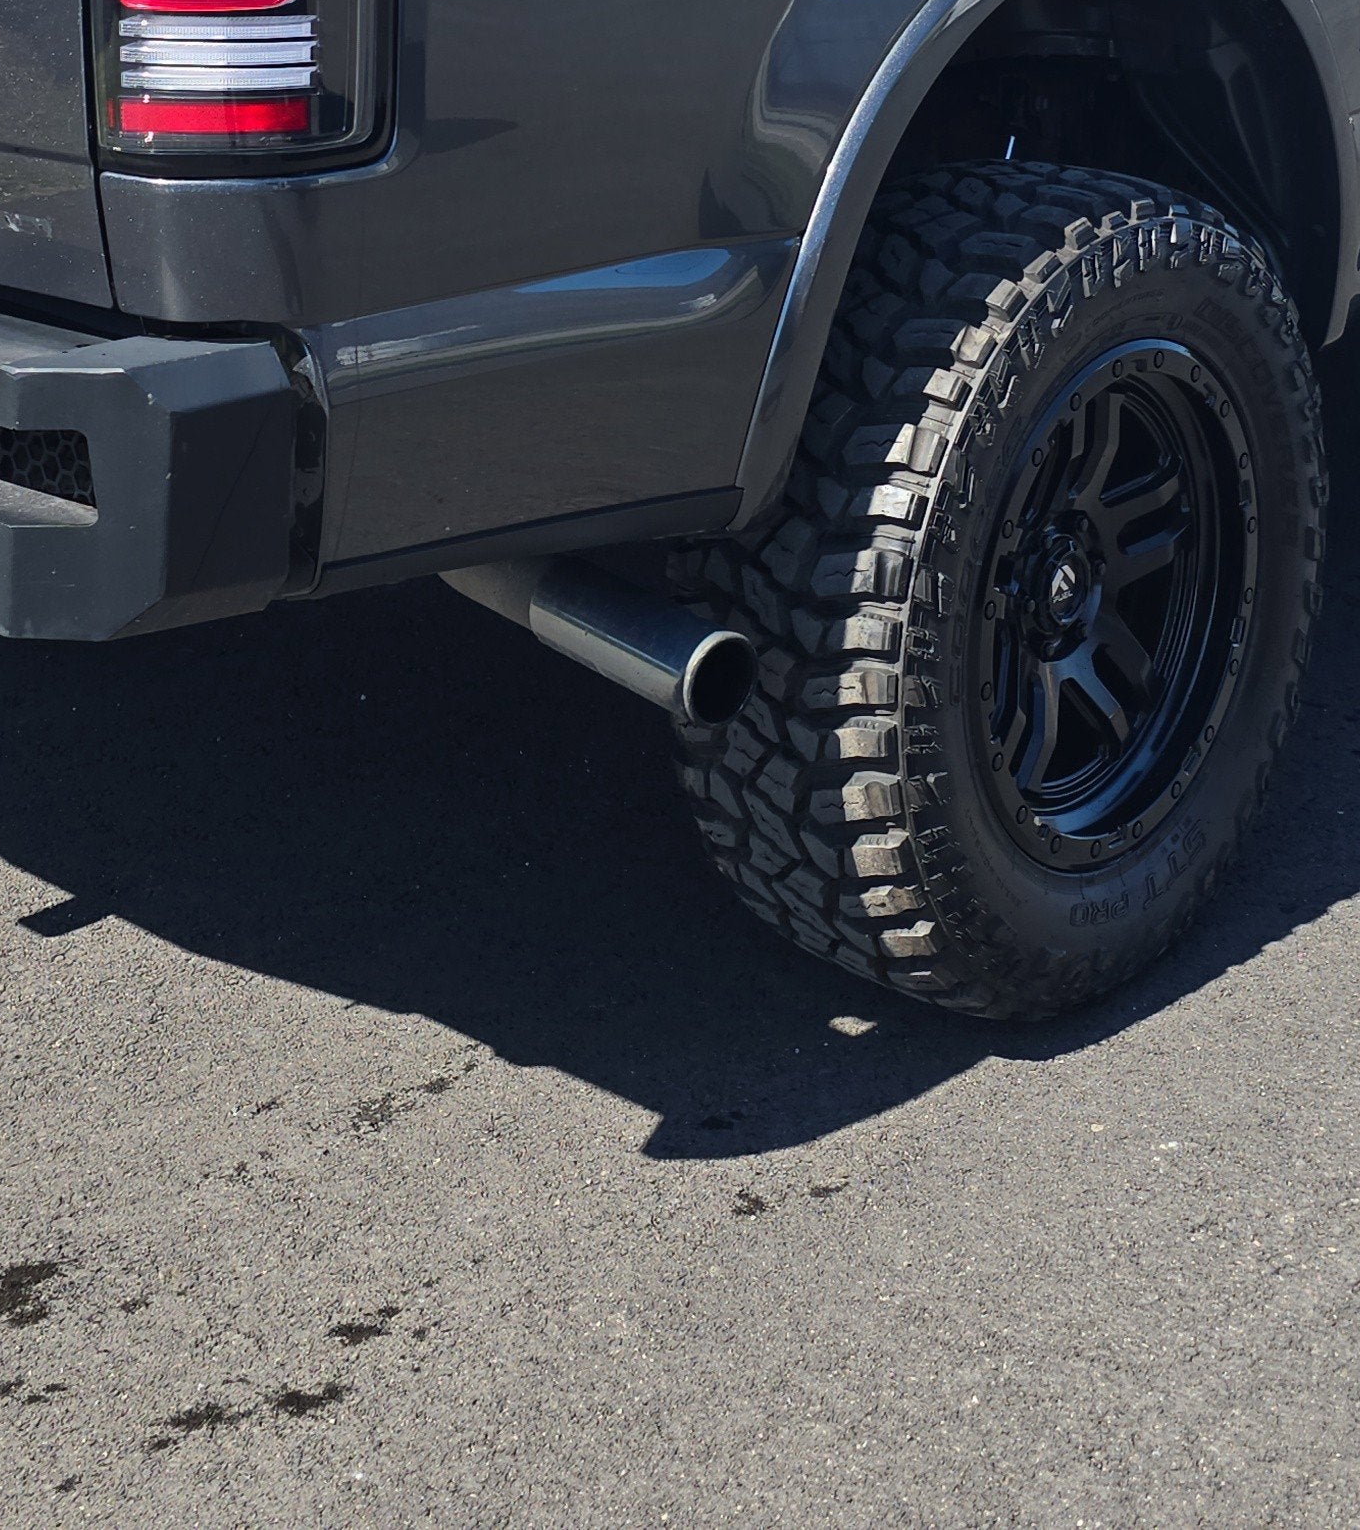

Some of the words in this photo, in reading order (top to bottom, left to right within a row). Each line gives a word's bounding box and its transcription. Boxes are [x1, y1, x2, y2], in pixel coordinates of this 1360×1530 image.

[1052, 591, 1073, 603] FUEL
[1142, 817, 1209, 910] STT
[1069, 889, 1130, 928] PRO
